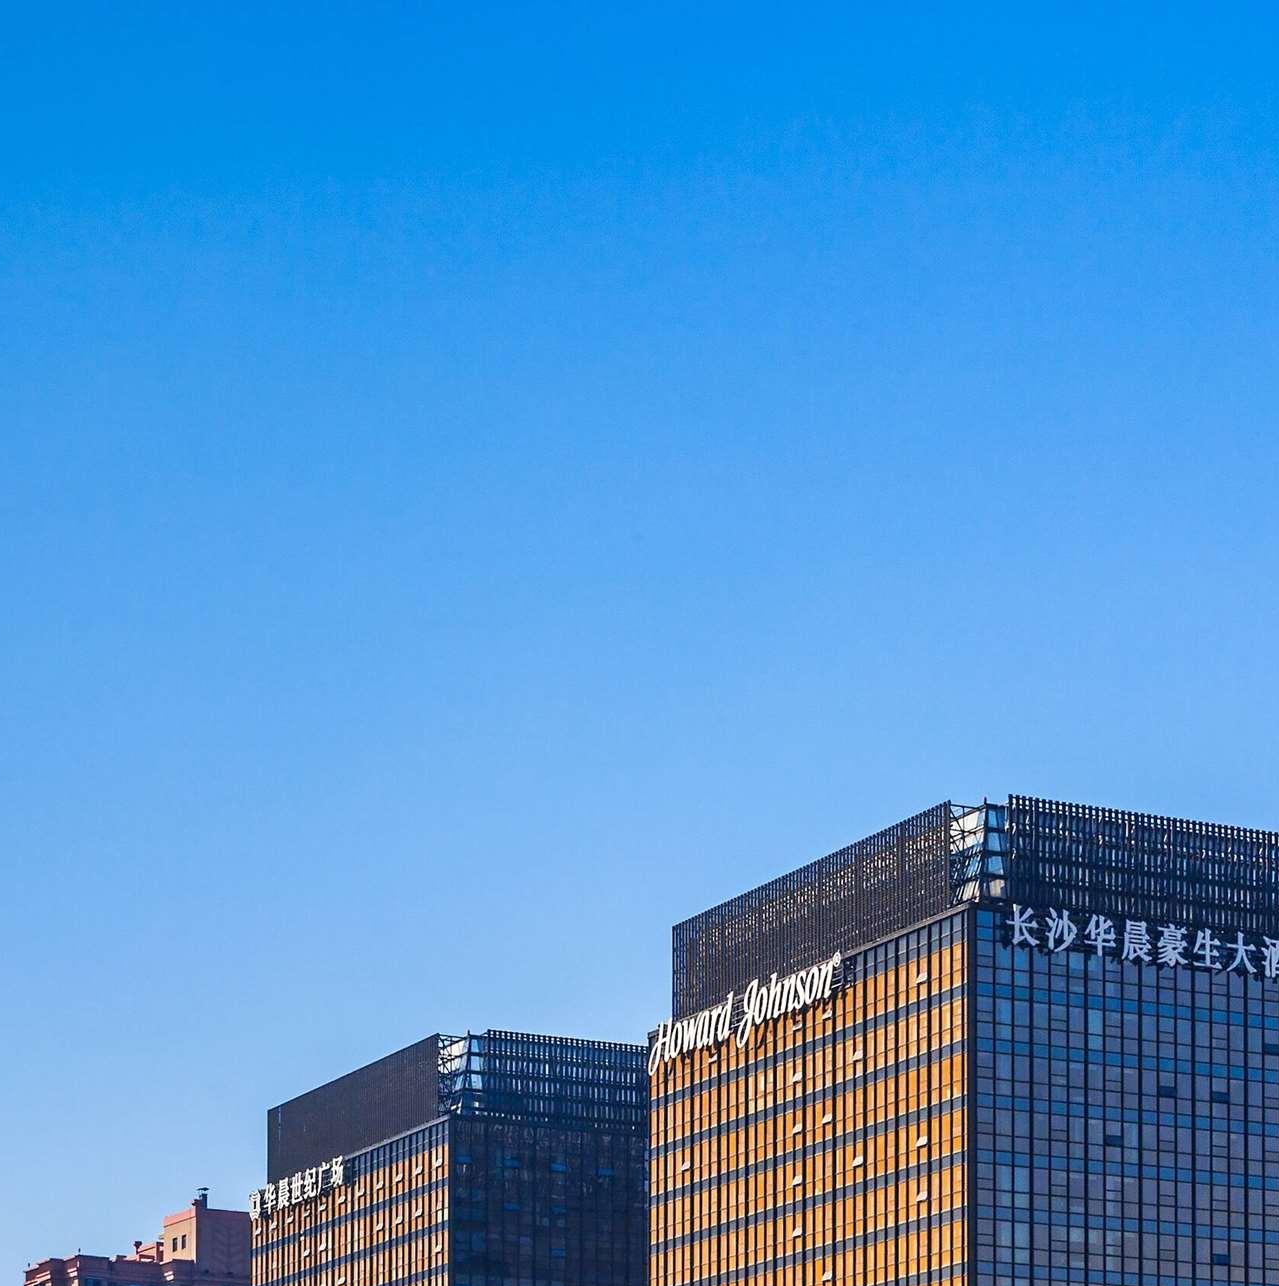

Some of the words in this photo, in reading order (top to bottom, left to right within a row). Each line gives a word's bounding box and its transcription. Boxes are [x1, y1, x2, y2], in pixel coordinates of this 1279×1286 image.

[648, 990, 734, 1076] Howard
[736, 962, 833, 1048] Johnson
[262, 1155, 345, 1215] 华晨世纪广场
